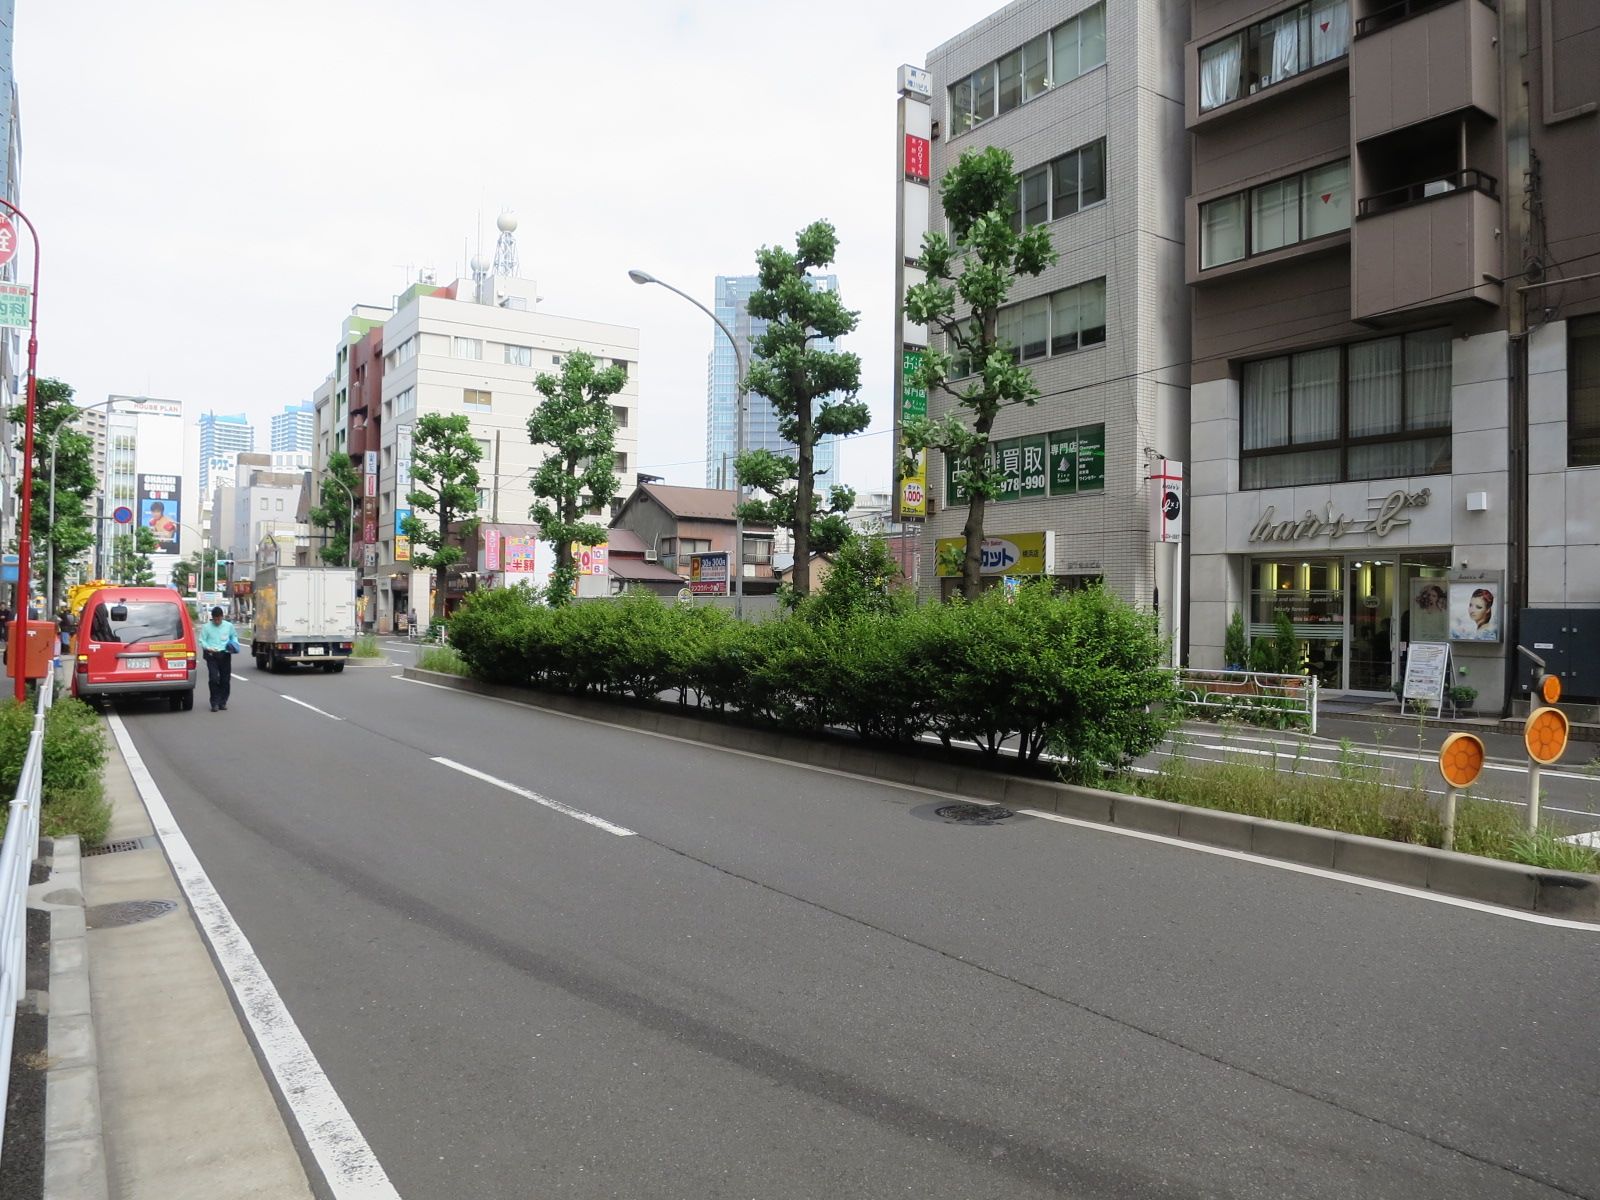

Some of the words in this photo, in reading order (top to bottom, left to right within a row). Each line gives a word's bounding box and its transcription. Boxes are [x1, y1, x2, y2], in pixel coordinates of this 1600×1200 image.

[903, 386, 926, 398] 専門店
[160, 405, 179, 413] PLAN
[1050, 441, 1078, 456] 専門店
[144, 474, 177, 485] OHASHI
[144, 483, 176, 493] BOXING
[1249, 501, 1346, 542] hair's
[512, 559, 535, 572] 半額
